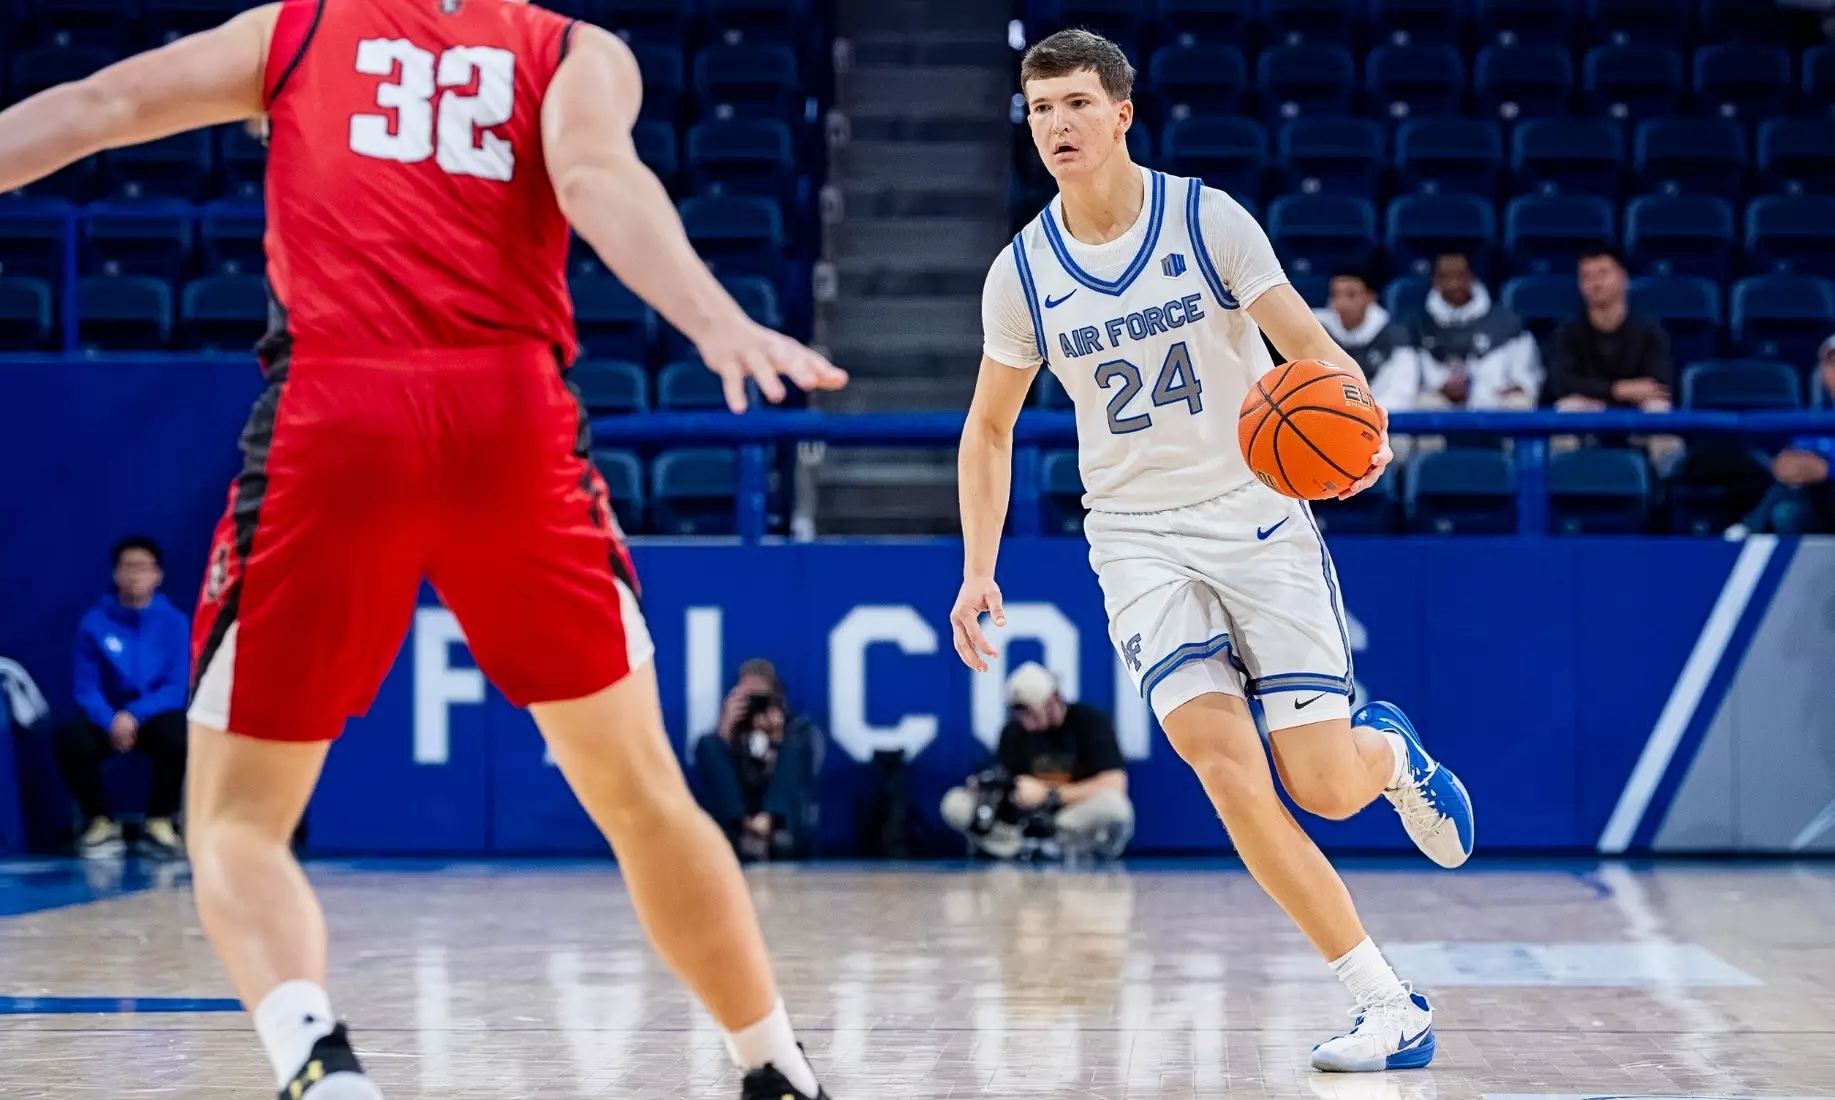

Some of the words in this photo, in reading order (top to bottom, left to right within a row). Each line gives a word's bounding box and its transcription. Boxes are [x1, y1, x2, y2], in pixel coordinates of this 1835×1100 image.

[349, 37, 516, 182] 32
[1058, 325, 1104, 358] AIR
[1104, 292, 1205, 348] FORCE
[1094, 341, 1203, 434] 24
